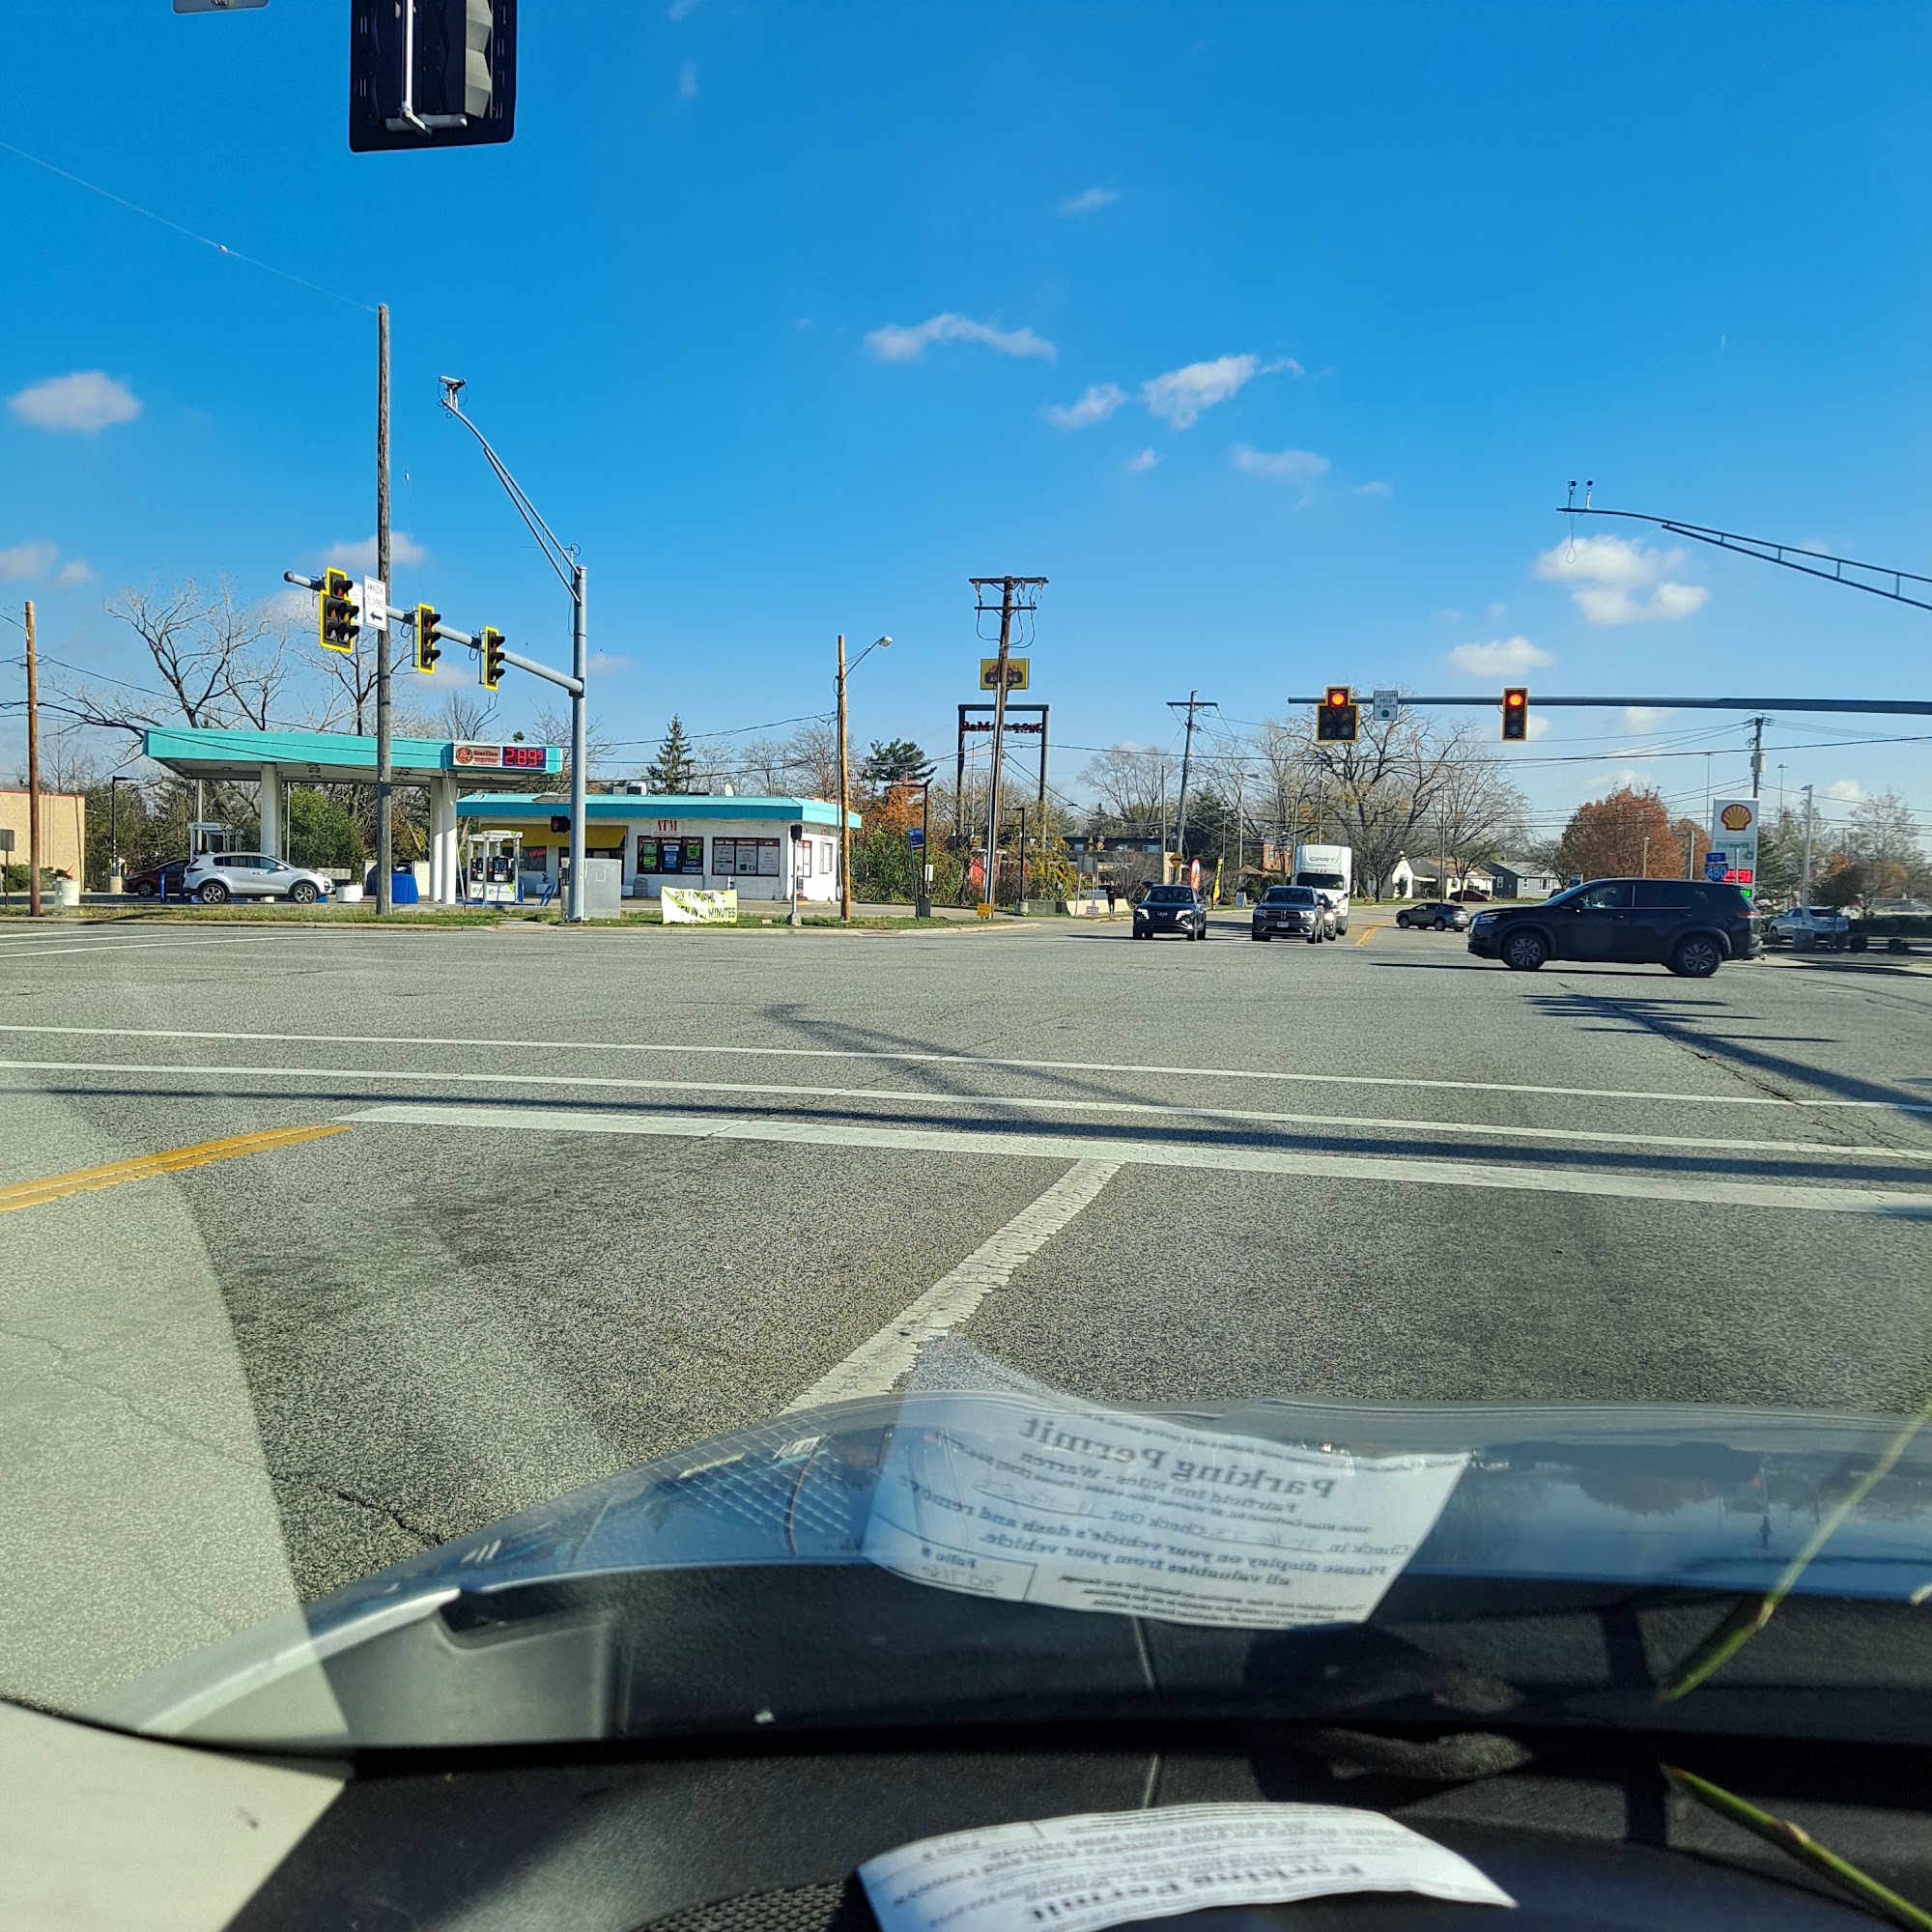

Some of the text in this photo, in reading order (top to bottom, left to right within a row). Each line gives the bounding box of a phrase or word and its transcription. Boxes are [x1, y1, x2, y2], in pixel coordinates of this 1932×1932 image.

[367, 582, 384, 595] AMAZON
[657, 819, 678, 832] ATM
[1707, 867, 1727, 877] 480
[708, 907, 736, 919] MINUTES
